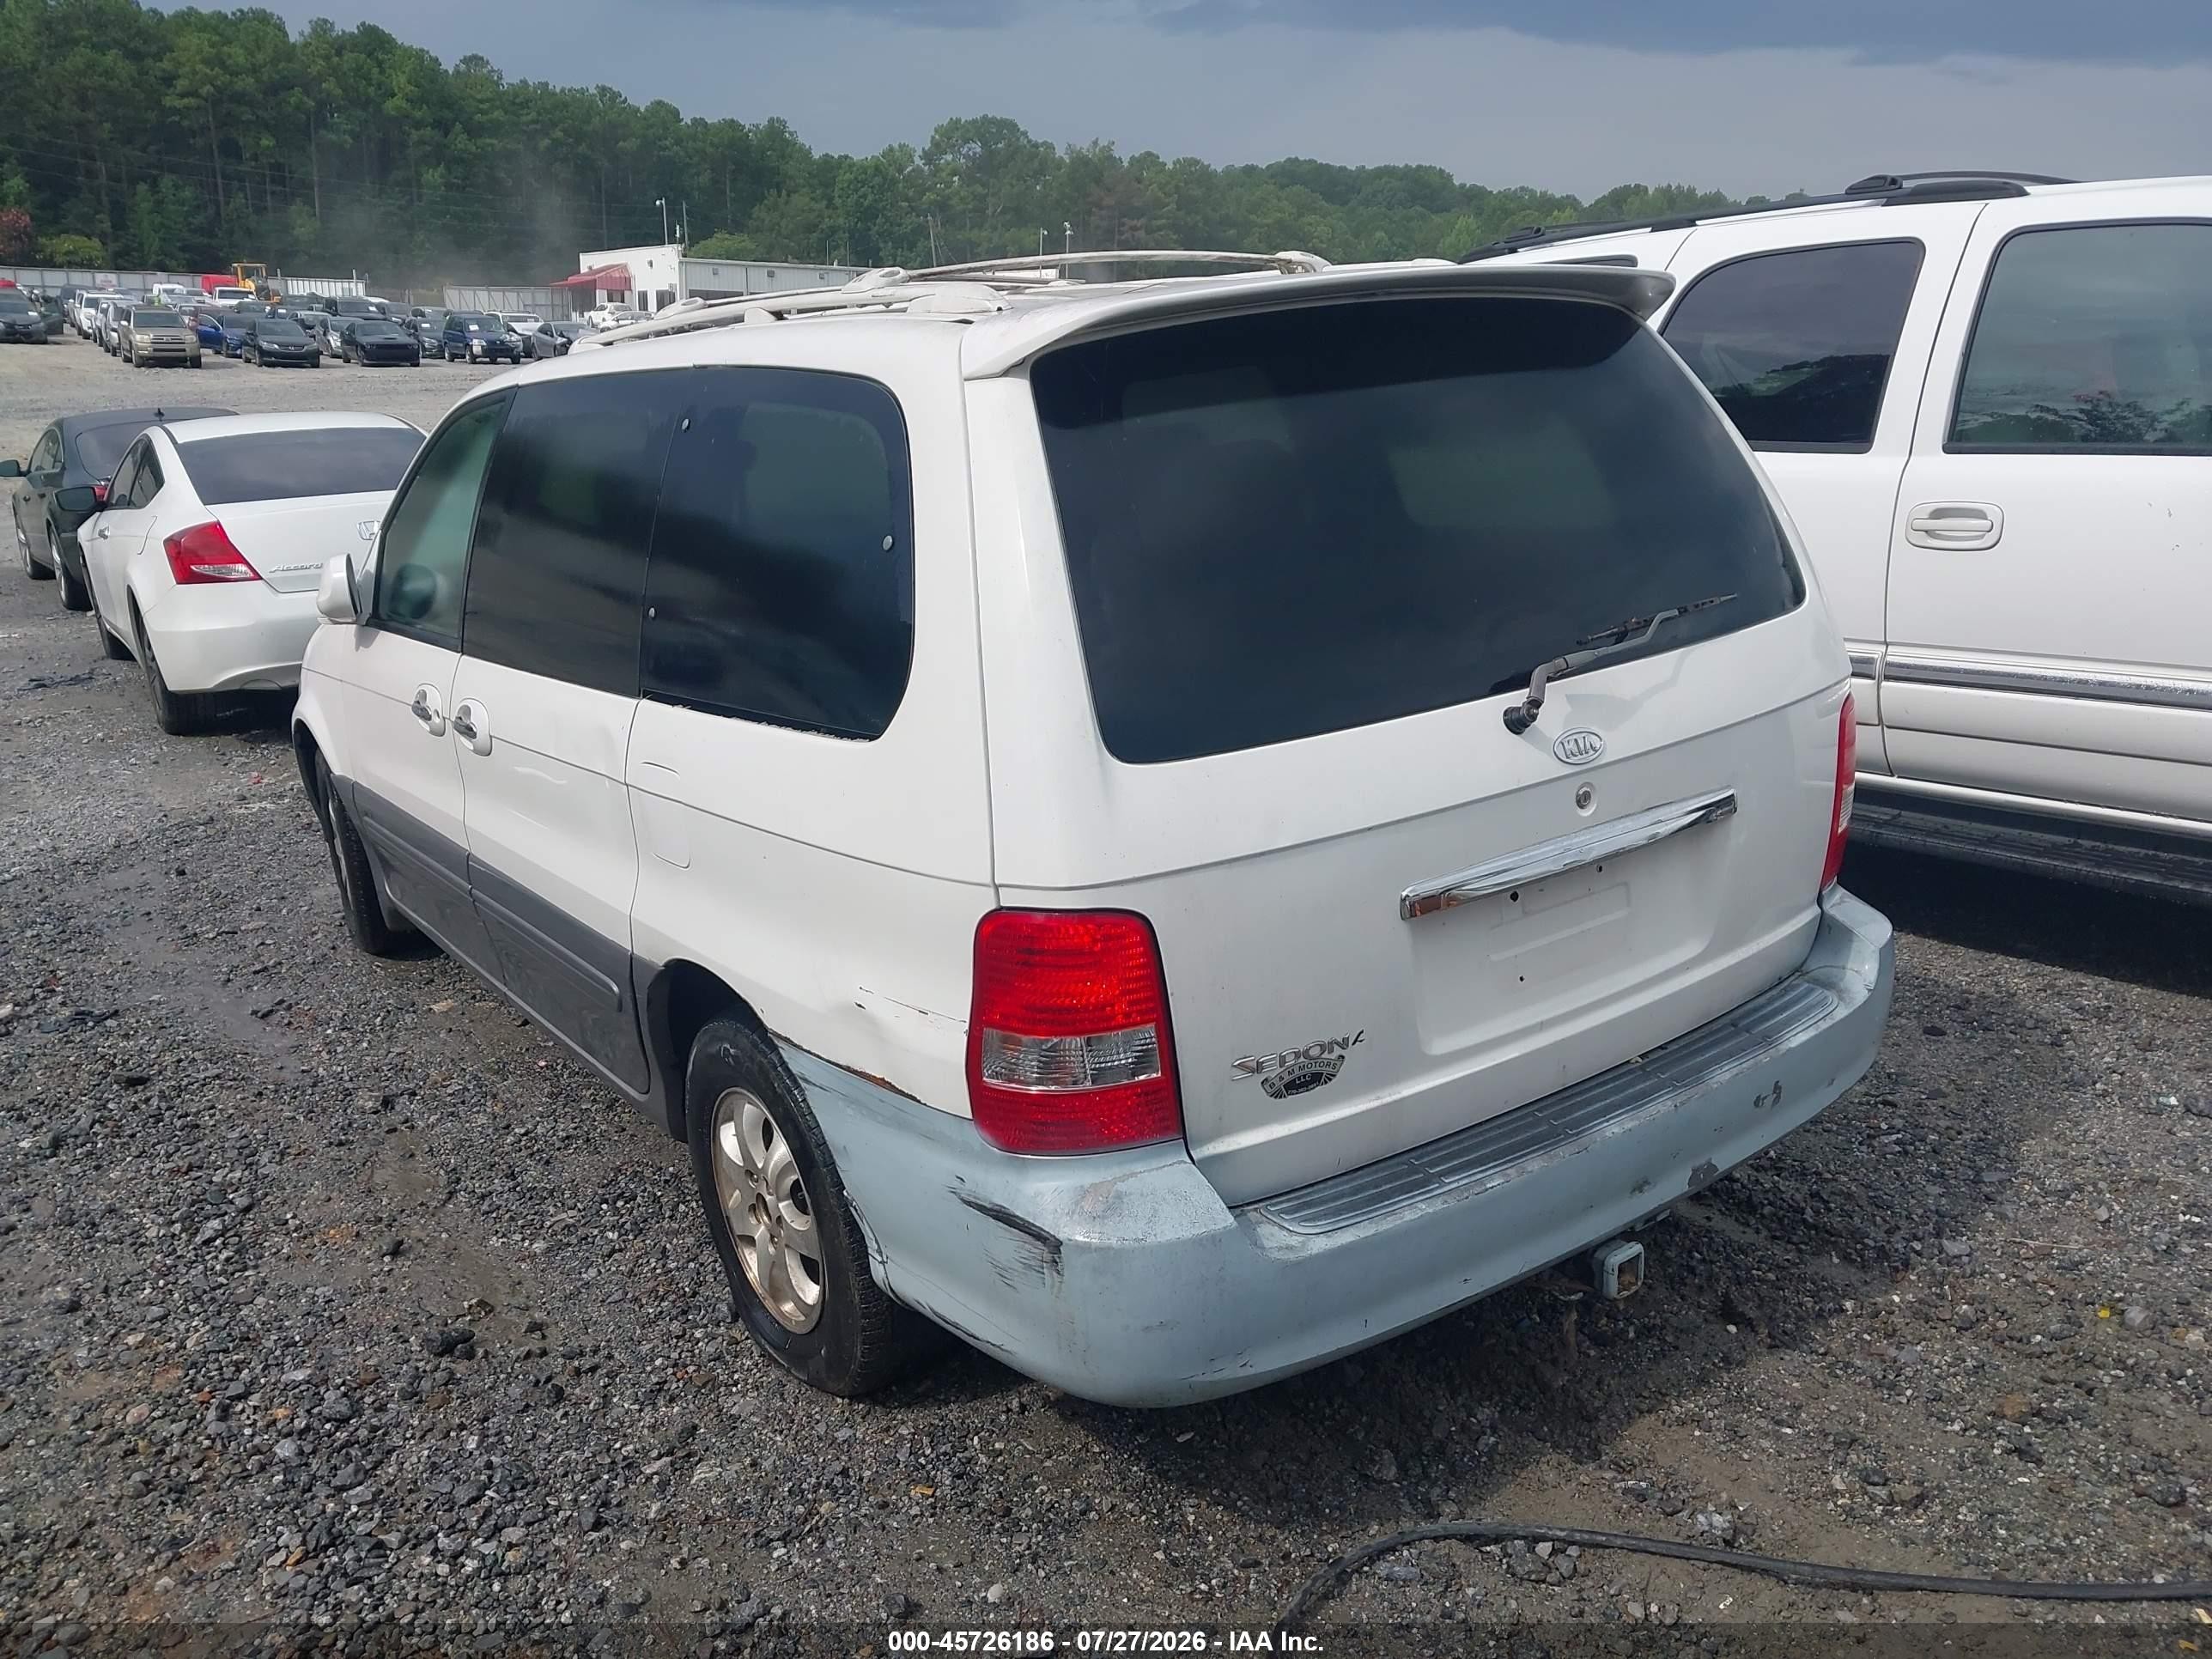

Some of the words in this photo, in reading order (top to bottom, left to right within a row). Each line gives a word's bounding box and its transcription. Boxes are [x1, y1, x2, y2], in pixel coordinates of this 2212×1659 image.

[269, 562, 324, 574] Accord
[1559, 735, 1600, 759] KIA
[1231, 1029, 1366, 1081] SEDONA
[1268, 1081, 1276, 1090] B
[1287, 1067, 1296, 1077] M
[1298, 1060, 1338, 1073] MOTORS
[1295, 1073, 1312, 1084] LLC
